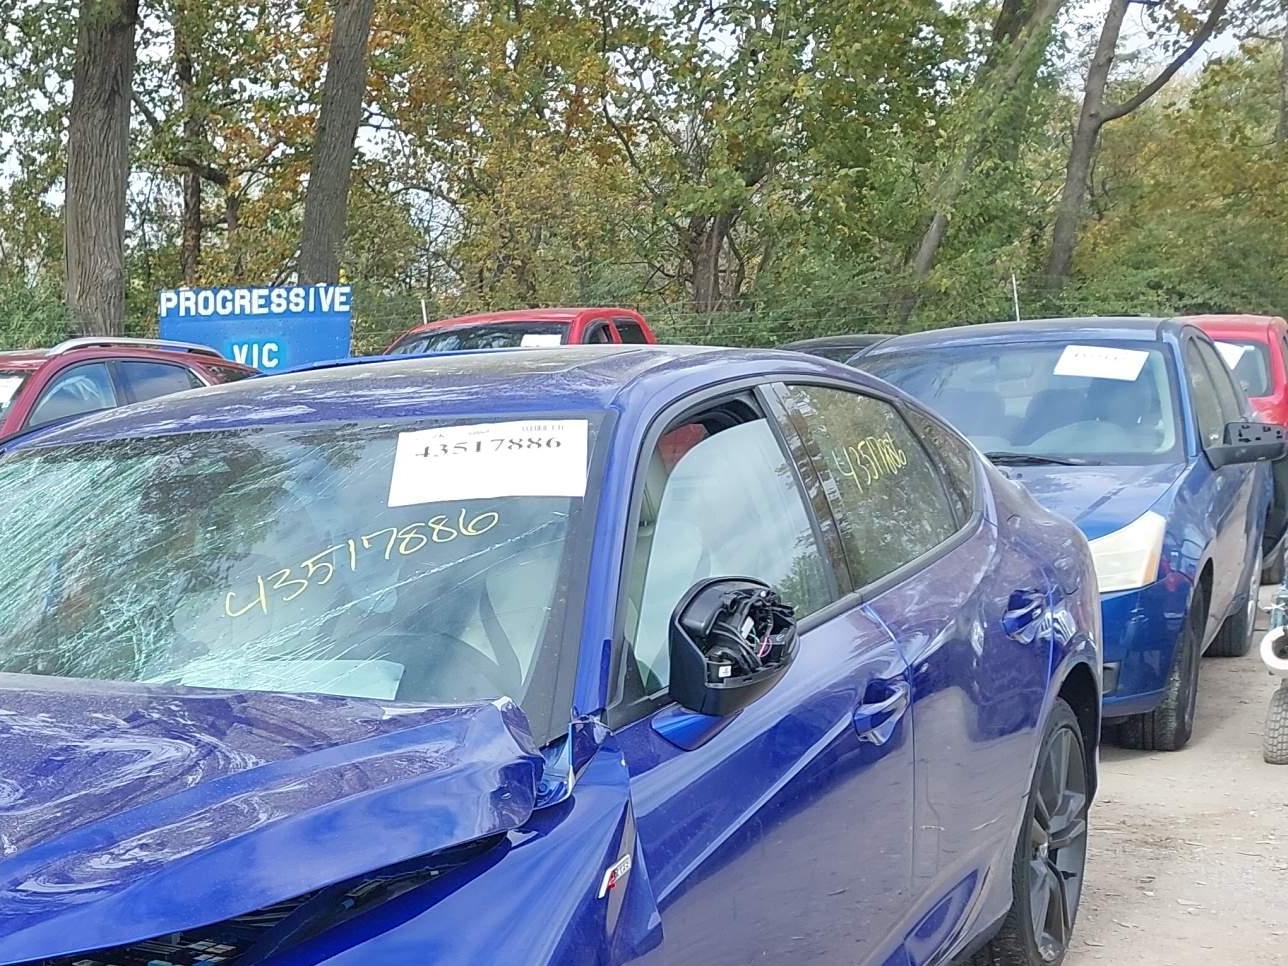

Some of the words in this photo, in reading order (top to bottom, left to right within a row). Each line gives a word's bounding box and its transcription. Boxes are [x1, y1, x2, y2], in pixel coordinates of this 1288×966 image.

[160, 286, 351, 317] PROGRESSIVE
[232, 342, 279, 369] VIC
[415, 437, 562, 459] 43517886
[224, 508, 499, 618] 43517886
